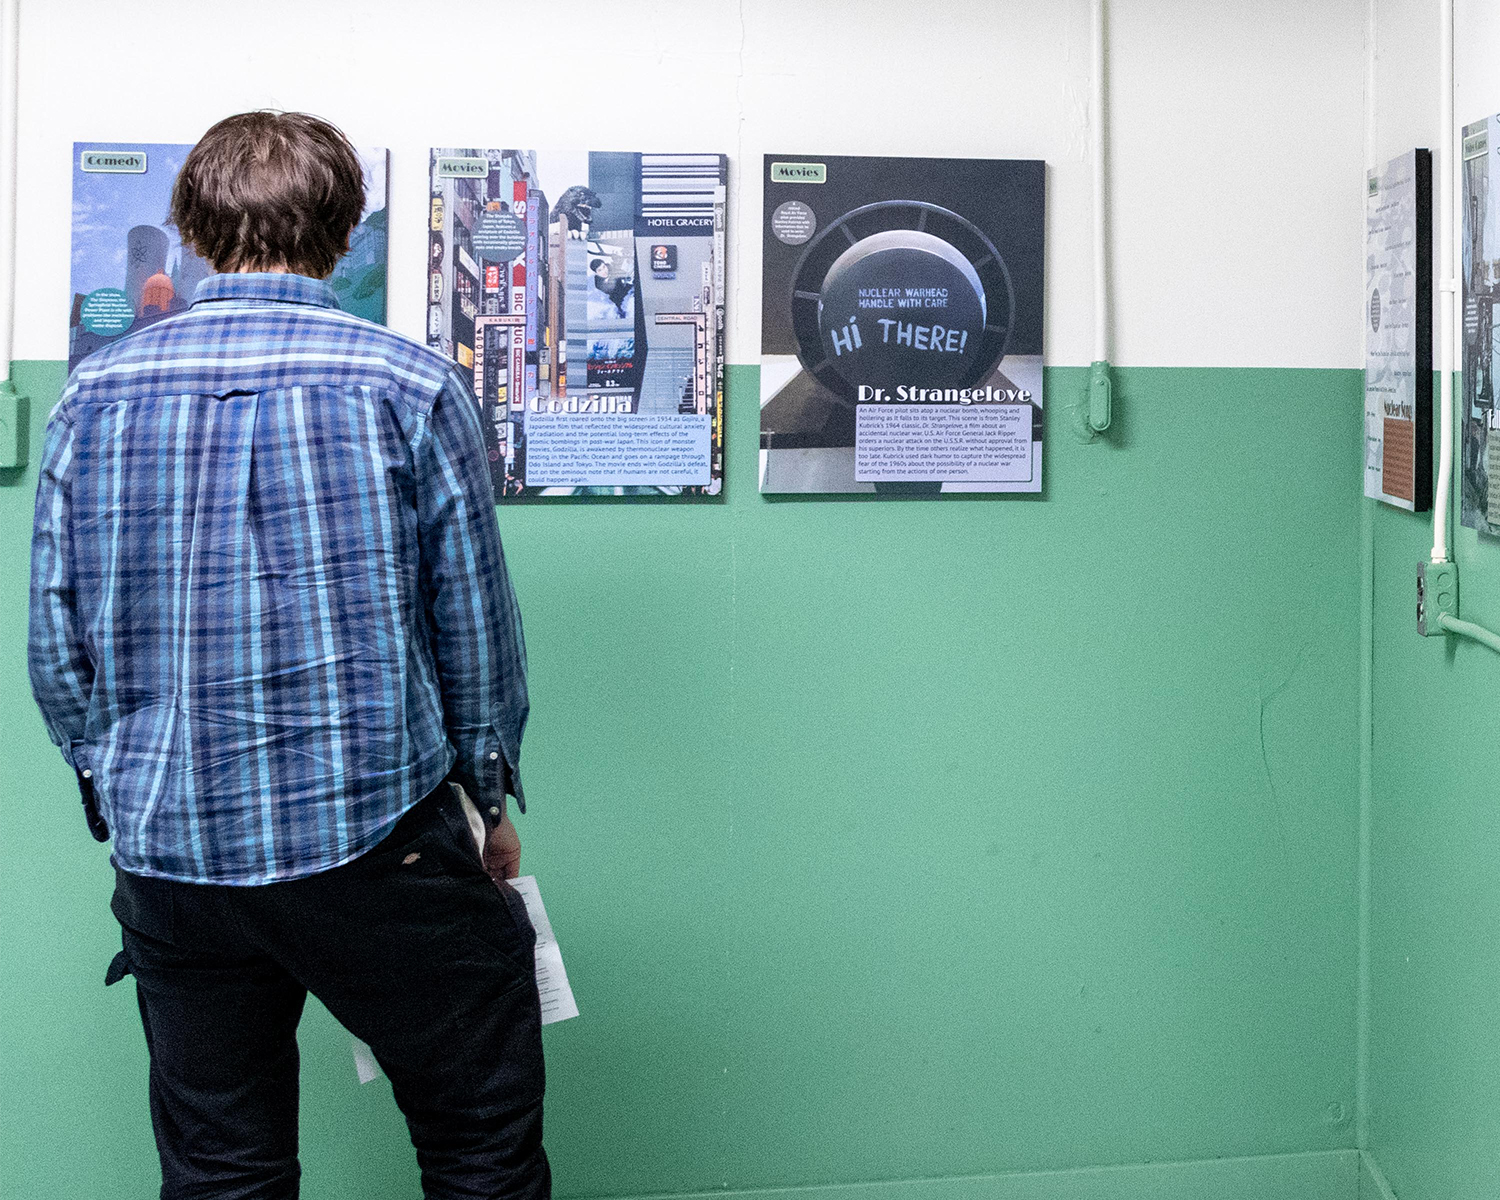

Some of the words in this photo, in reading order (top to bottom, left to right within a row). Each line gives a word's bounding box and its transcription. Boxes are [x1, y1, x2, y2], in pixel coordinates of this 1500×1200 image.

[88, 156, 140, 167] Comedy
[442, 163, 484, 172] Movies
[780, 167, 818, 176] Movies
[859, 288, 900, 297] NUCLEAR
[905, 288, 948, 297] WARHEAD
[514, 293, 523, 310] BIC
[859, 299, 894, 308] HANDLE
[898, 299, 921, 308] WITH
[924, 299, 948, 308] CARE
[878, 319, 968, 354] THERE!
[858, 385, 890, 401] Dr.
[896, 385, 1031, 405] Strangelove
[530, 395, 632, 414] Godzilla
